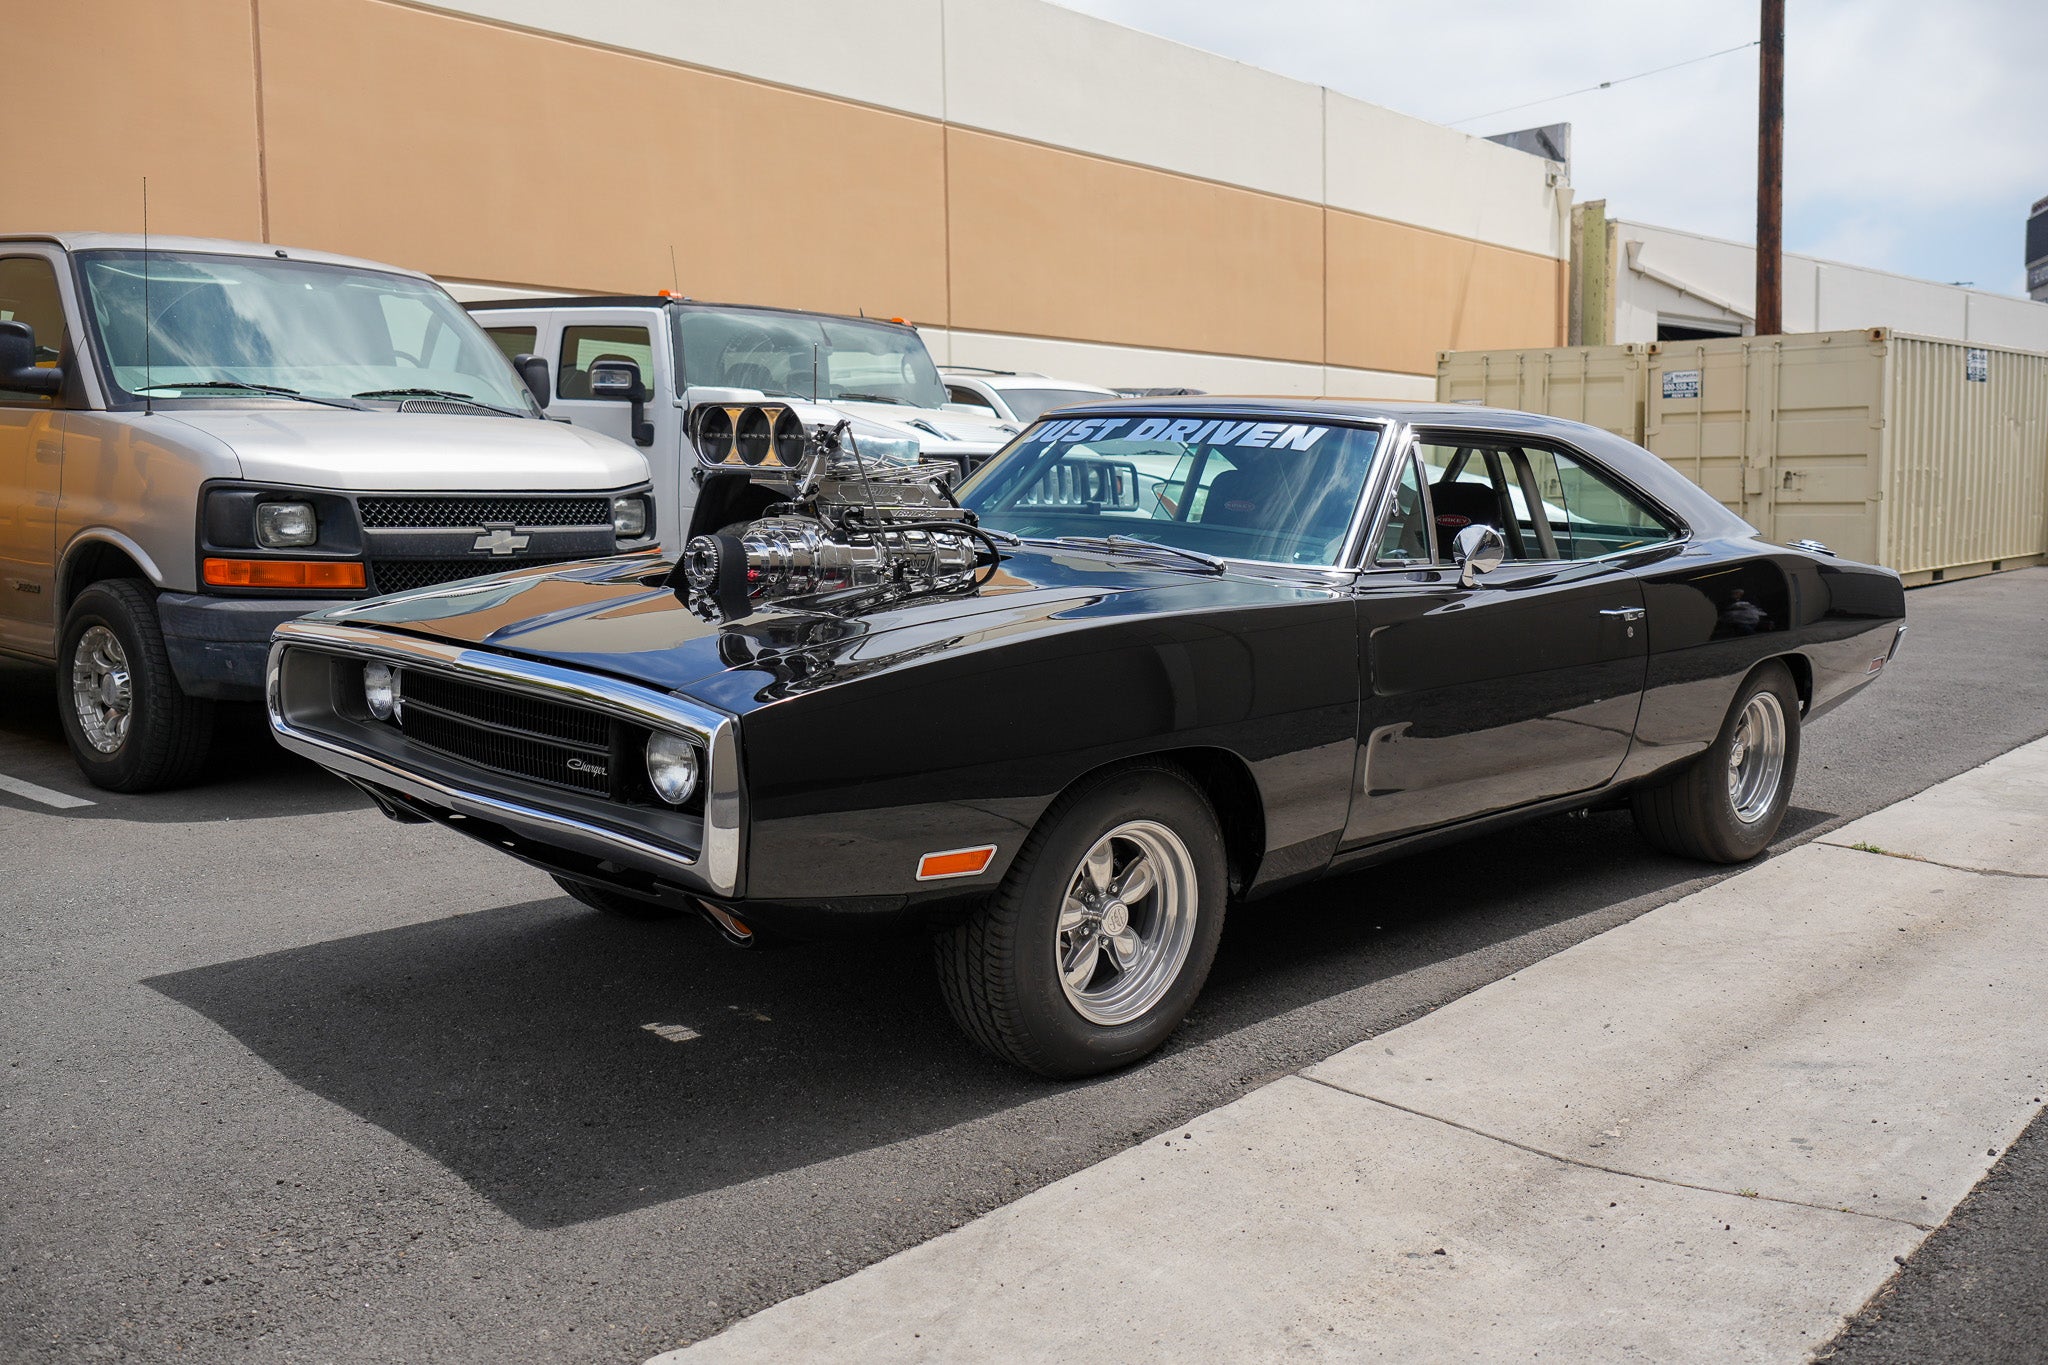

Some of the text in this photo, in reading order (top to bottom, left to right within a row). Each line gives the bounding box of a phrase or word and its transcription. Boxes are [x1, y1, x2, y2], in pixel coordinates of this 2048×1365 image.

[1023, 418, 1329, 451] JUST DRIVEN
[566, 758, 608, 777] Charger
